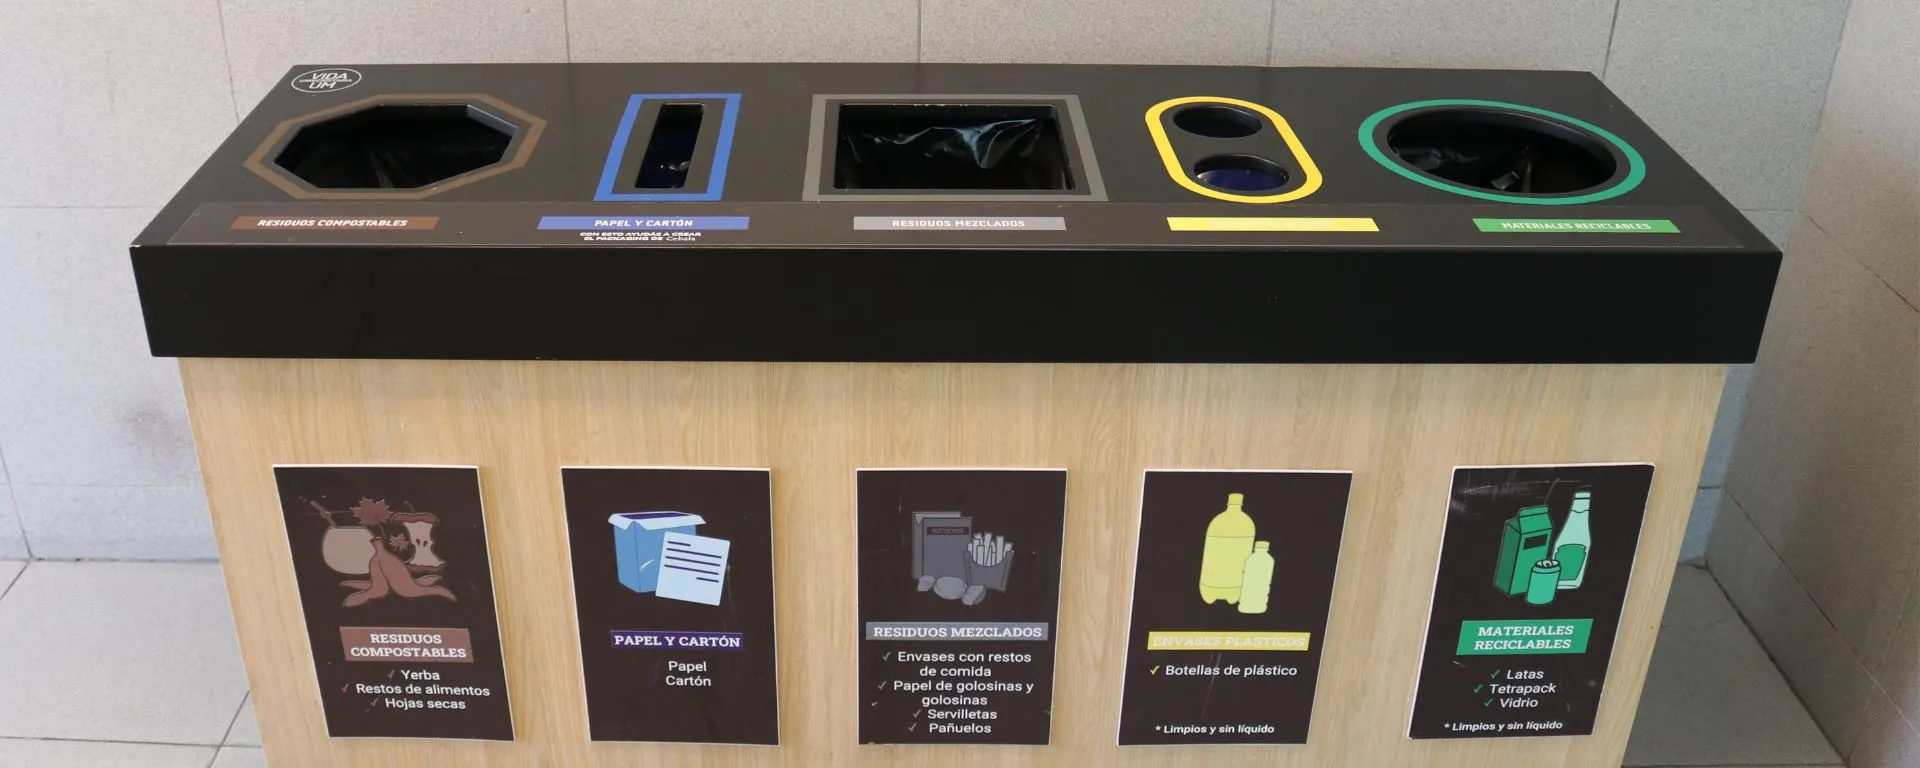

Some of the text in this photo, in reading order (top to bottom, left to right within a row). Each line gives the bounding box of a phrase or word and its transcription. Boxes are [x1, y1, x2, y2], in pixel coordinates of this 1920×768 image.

[312, 72, 348, 80] VIDA
[257, 219, 408, 227] RESIDUOS COMPOSTABLES
[594, 218, 693, 227] PAPEL Y CARTÓN
[1576, 222, 1651, 230] RECICLABLES
[873, 627, 1042, 637] RESIDUOS MEZCLADOS
[1477, 626, 1574, 637] MATERIALES
[370, 634, 442, 644] RESIDUOS
[614, 635, 740, 647] PAPEL Y CARTÓN
[1153, 635, 1305, 647] ENVASES PLÁSTICOS
[1474, 639, 1572, 650] RECICLABLES
[350, 647, 467, 658] COMPOSTABLES
[898, 652, 1032, 662] Envases con restos
[668, 661, 707, 673] Papel
[920, 666, 991, 677] de comida
[1165, 665, 1298, 677] Botellas de plástico
[401, 670, 440, 681] Yerba
[665, 675, 711, 686] Cartón
[1507, 670, 1544, 680] Latas
[356, 684, 491, 696] Restos de alimentos
[894, 681, 1034, 693] Papel de golosinas y
[1490, 683, 1557, 696] Tetrapack
[385, 698, 466, 710] Hojas secas
[922, 695, 988, 707] golosinas
[1500, 698, 1538, 708] Vidrio
[927, 709, 998, 720] Servilletas
[929, 723, 991, 734] Pañuelos
[1164, 724, 1274, 736] Limpios y sin líquido
[1452, 721, 1563, 733] Limpios y sin líquido
